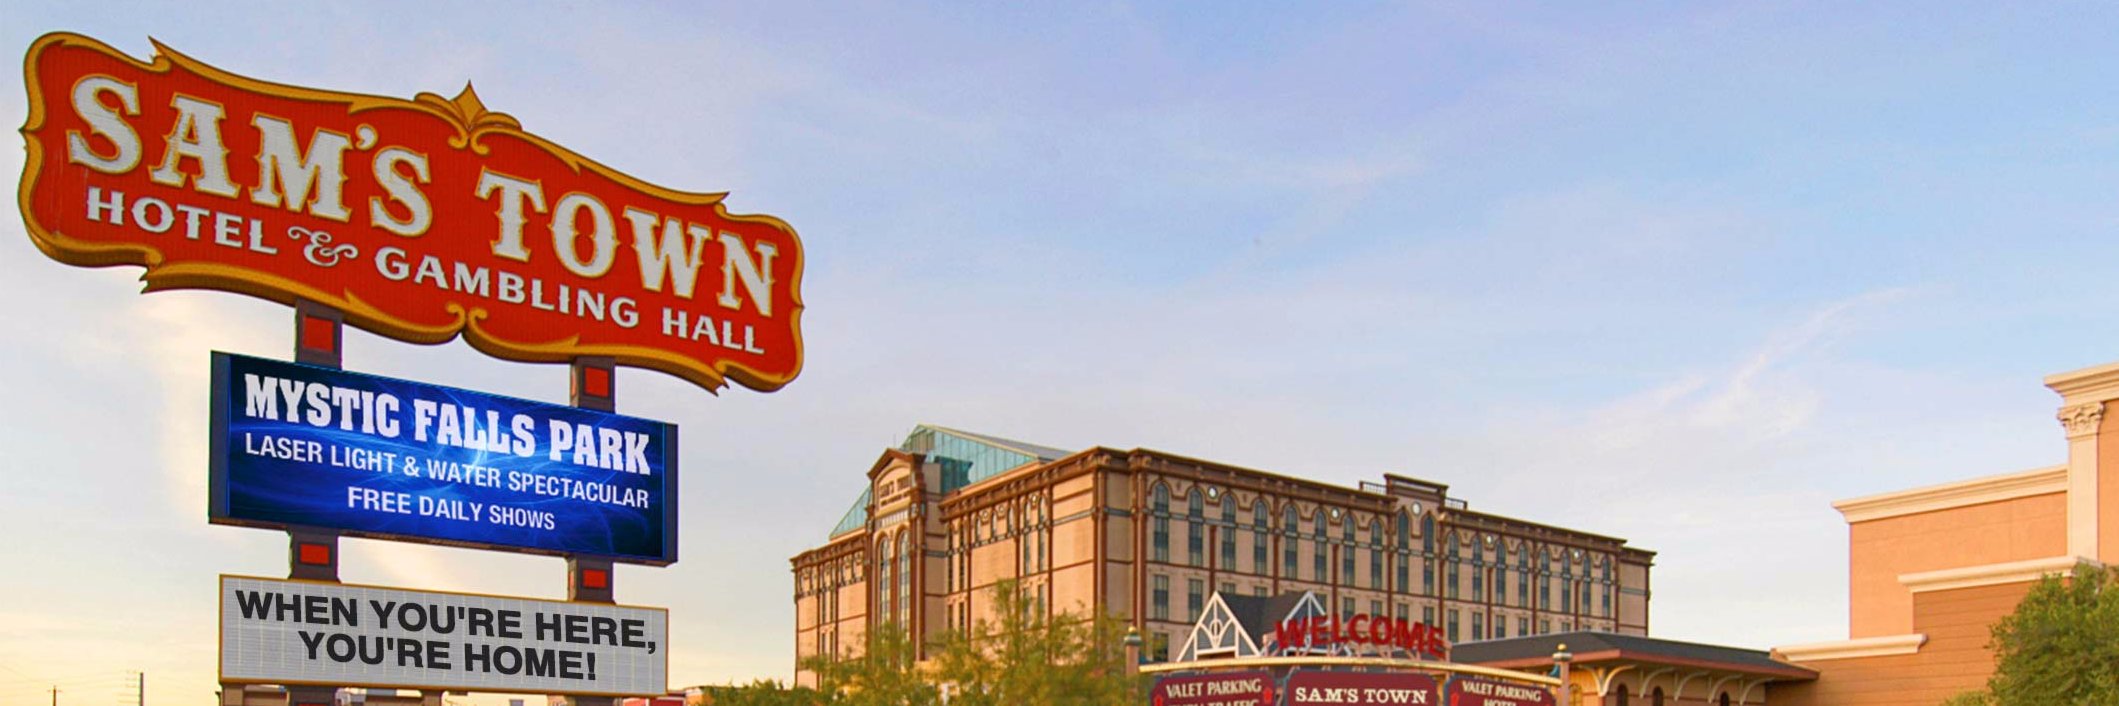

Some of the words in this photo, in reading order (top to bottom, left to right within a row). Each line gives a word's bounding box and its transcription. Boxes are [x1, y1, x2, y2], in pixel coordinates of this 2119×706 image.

[68, 73, 432, 238] SAM'S
[475, 165, 778, 317] TOWN
[86, 187, 277, 255] HOTEL
[287, 225, 358, 267] &
[374, 248, 640, 328] GAMBLING
[661, 305, 765, 355] HALL
[244, 373, 400, 438] MYSTIC
[413, 398, 535, 457] FALLS
[549, 418, 652, 475] PARK
[245, 433, 323, 464] LASER
[331, 448, 397, 475] LIGHT
[403, 456, 420, 478] &
[427, 460, 500, 488] WATER
[508, 472, 649, 510] SPECTACULAR
[347, 486, 412, 516] FREE
[418, 496, 484, 523] DAILY
[489, 504, 555, 531] SHOWS
[235, 590, 358, 627] WHEN
[369, 600, 523, 640] YOU'RE
[535, 612, 657, 656] HERE,
[1275, 613, 1446, 660] WELCOME
[298, 630, 452, 671] YOU'RE
[464, 643, 597, 681] HOME!
[1165, 682, 1204, 699] VALET
[1206, 678, 1262, 696] PARKING
[1295, 686, 1359, 703] SAM'S
[1364, 688, 1428, 704] TOWN
[1462, 680, 1494, 696] VALET
[1495, 684, 1542, 702] PARKING
